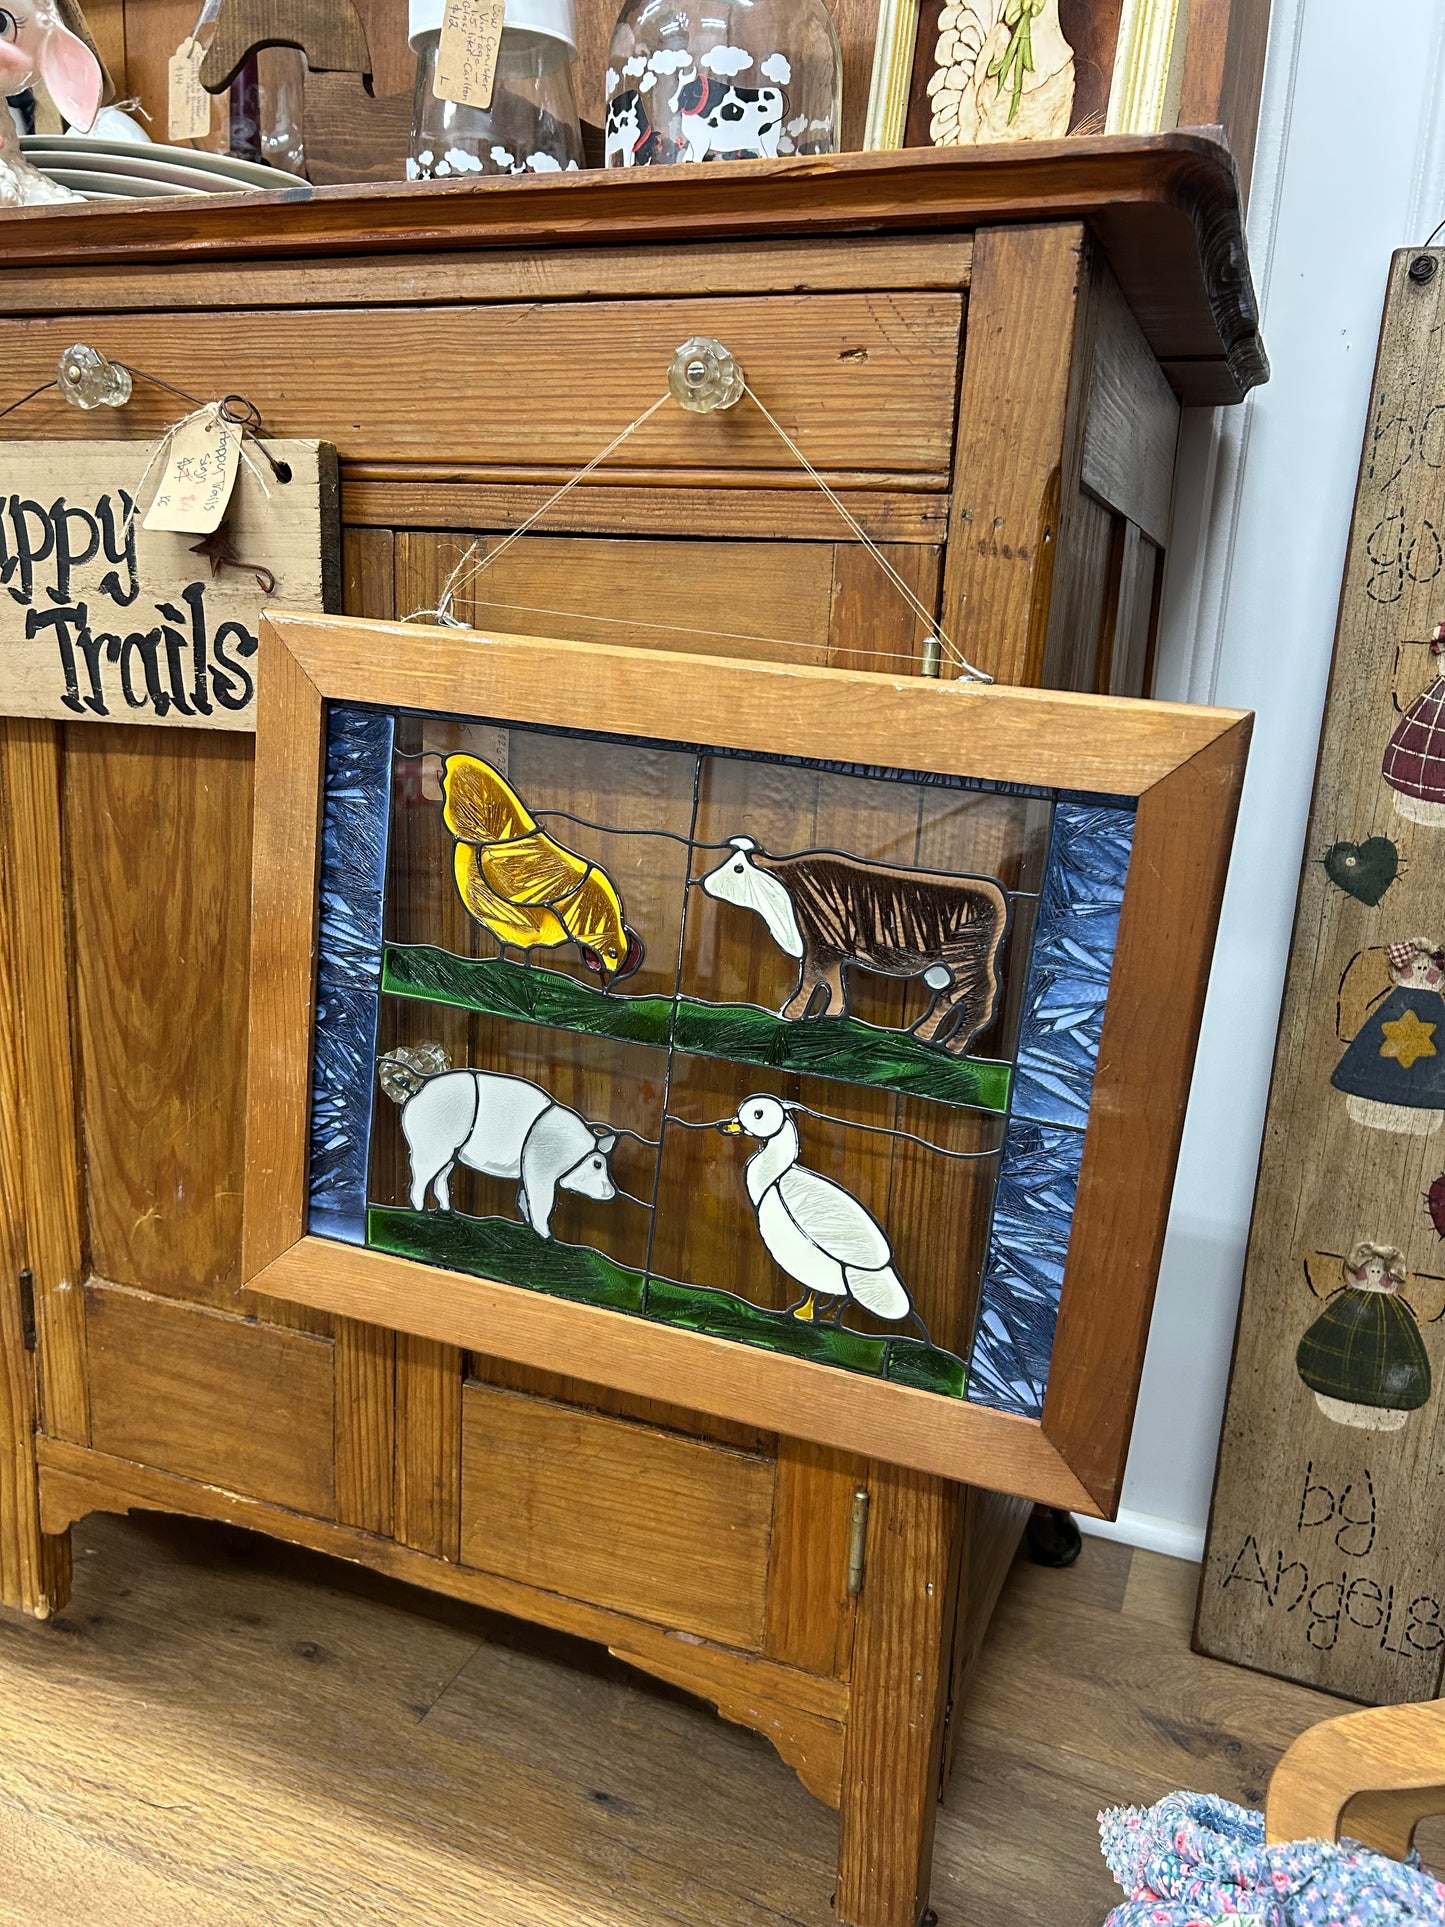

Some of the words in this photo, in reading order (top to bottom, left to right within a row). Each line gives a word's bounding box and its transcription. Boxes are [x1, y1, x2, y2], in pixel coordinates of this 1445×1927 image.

[491, 3, 501, 29] Cow
[482, 36, 497, 93] Canister
[212, 430, 231, 476] Happy
[26, 582, 259, 717] Trails
[1298, 1460, 1376, 1557] by
